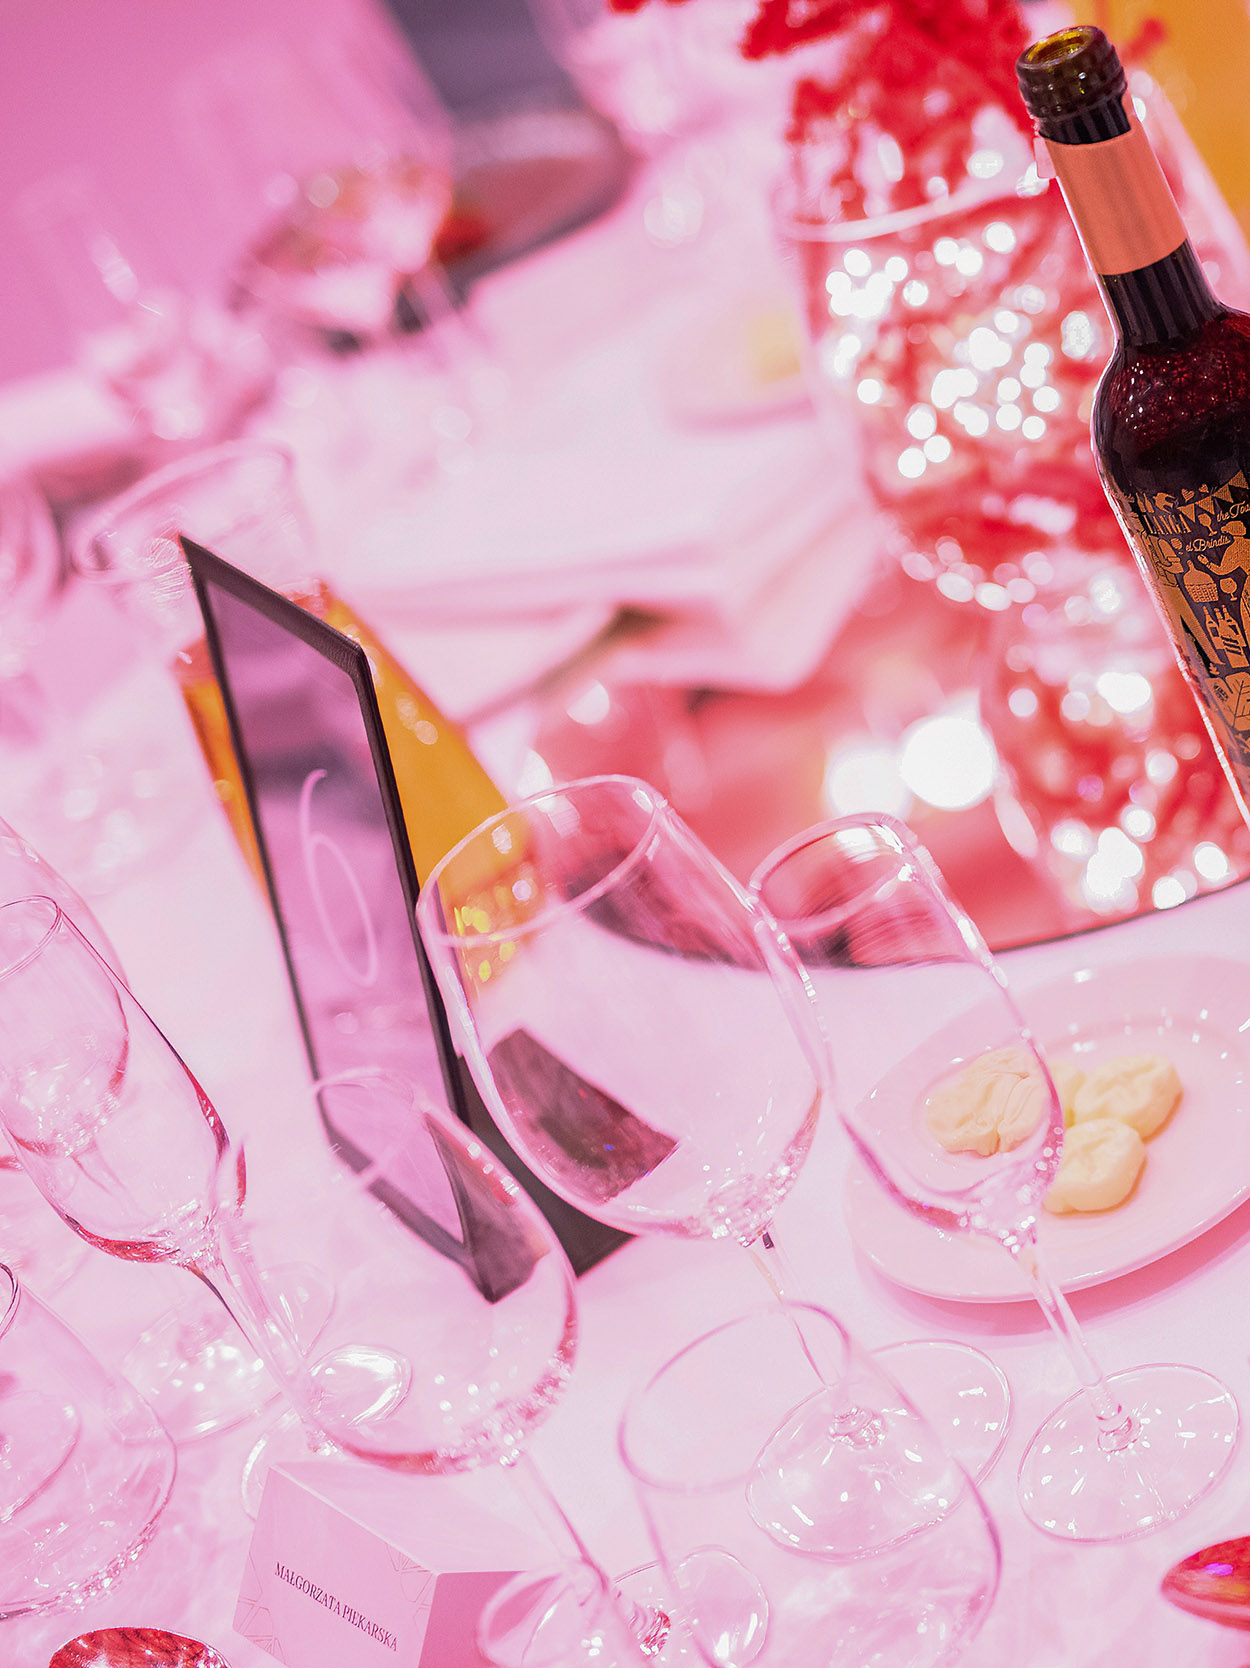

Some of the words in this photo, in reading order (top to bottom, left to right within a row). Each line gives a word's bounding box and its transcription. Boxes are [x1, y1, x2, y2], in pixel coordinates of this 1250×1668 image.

[1143, 514, 1191, 535] LANGA
[274, 1561, 340, 1616] MAŁGORZATA
[341, 1604, 398, 1652] PIEKARSKA
